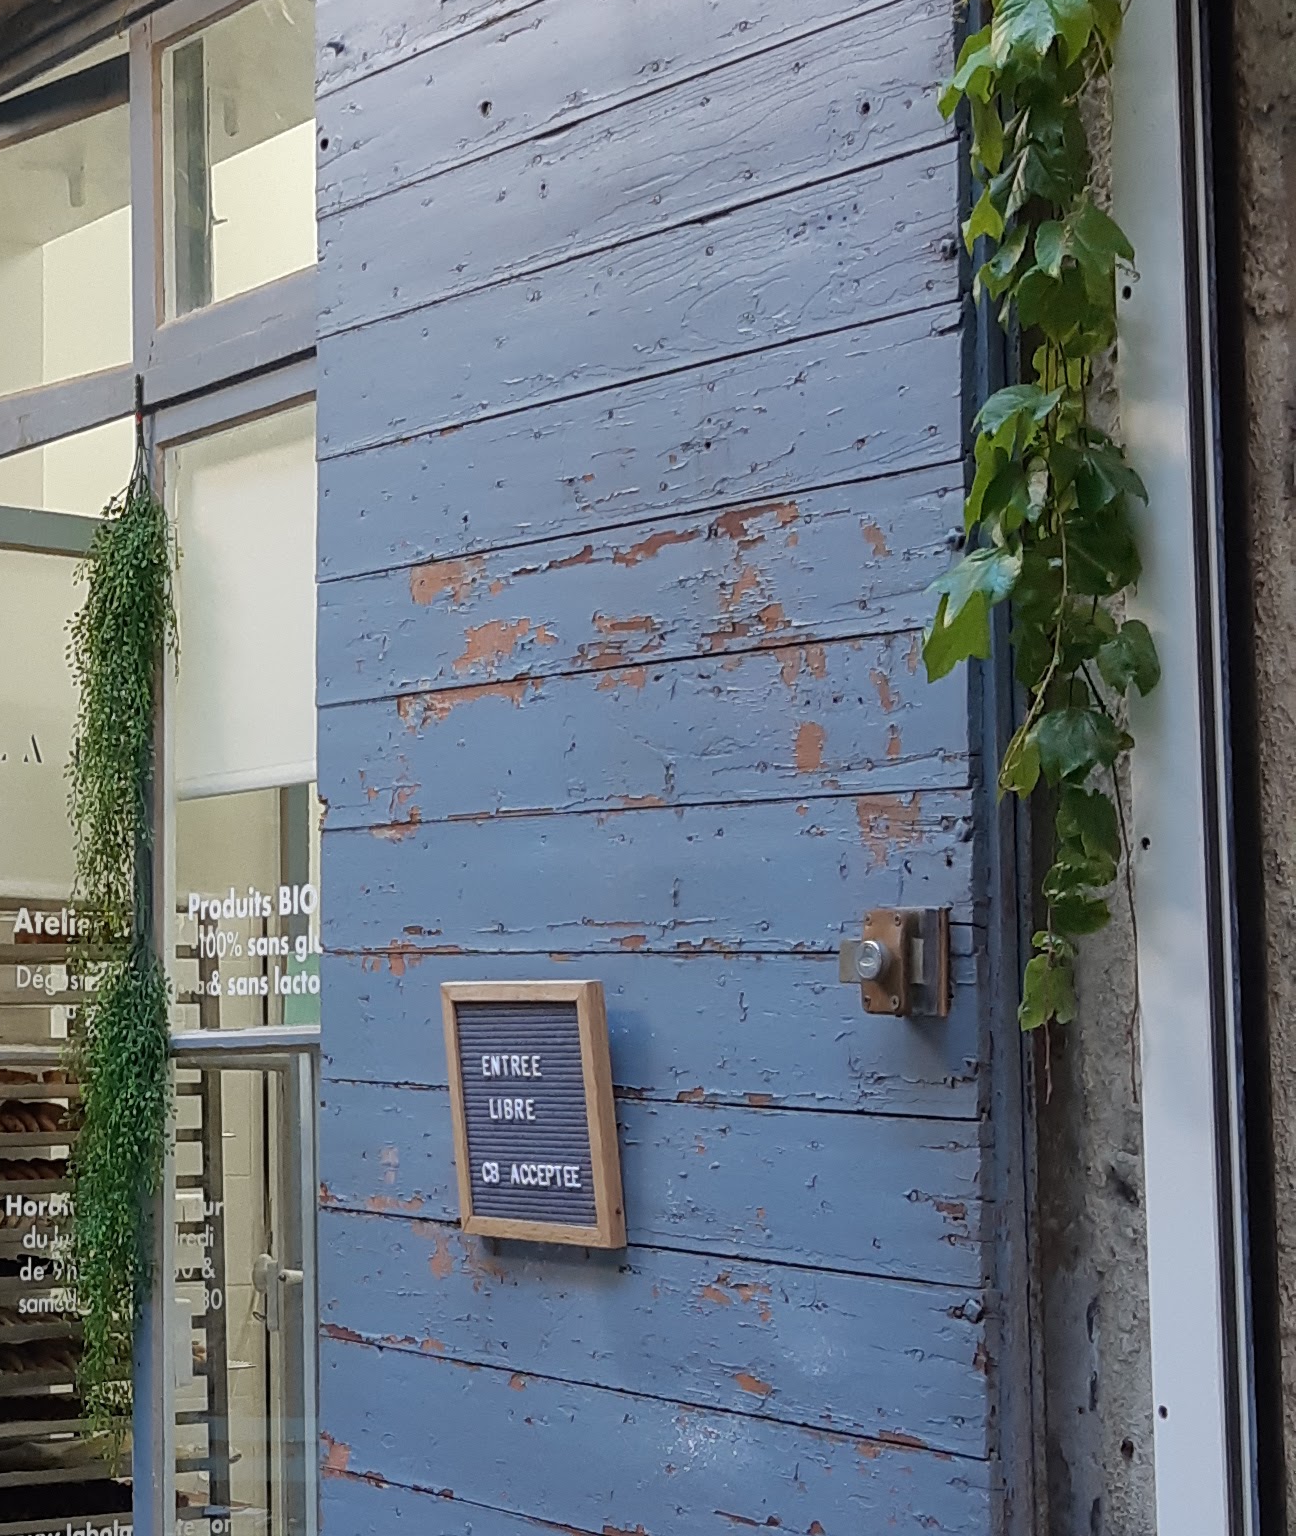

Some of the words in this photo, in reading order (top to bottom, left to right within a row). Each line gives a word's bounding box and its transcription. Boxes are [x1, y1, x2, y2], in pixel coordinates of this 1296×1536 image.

[188, 890, 272, 921] Produits
[277, 884, 318, 916] BIO
[199, 931, 243, 959] 100%
[247, 935, 289, 957] sans
[227, 975, 269, 996] sans
[274, 965, 321, 995] lacto
[481, 1054, 542, 1078] ENTREE
[488, 1098, 536, 1121] LIBRE
[481, 1161, 500, 1184] CB
[510, 1163, 582, 1188] ACCEPTEE
[23, 1224, 48, 1249] du
[19, 1256, 45, 1281] de
